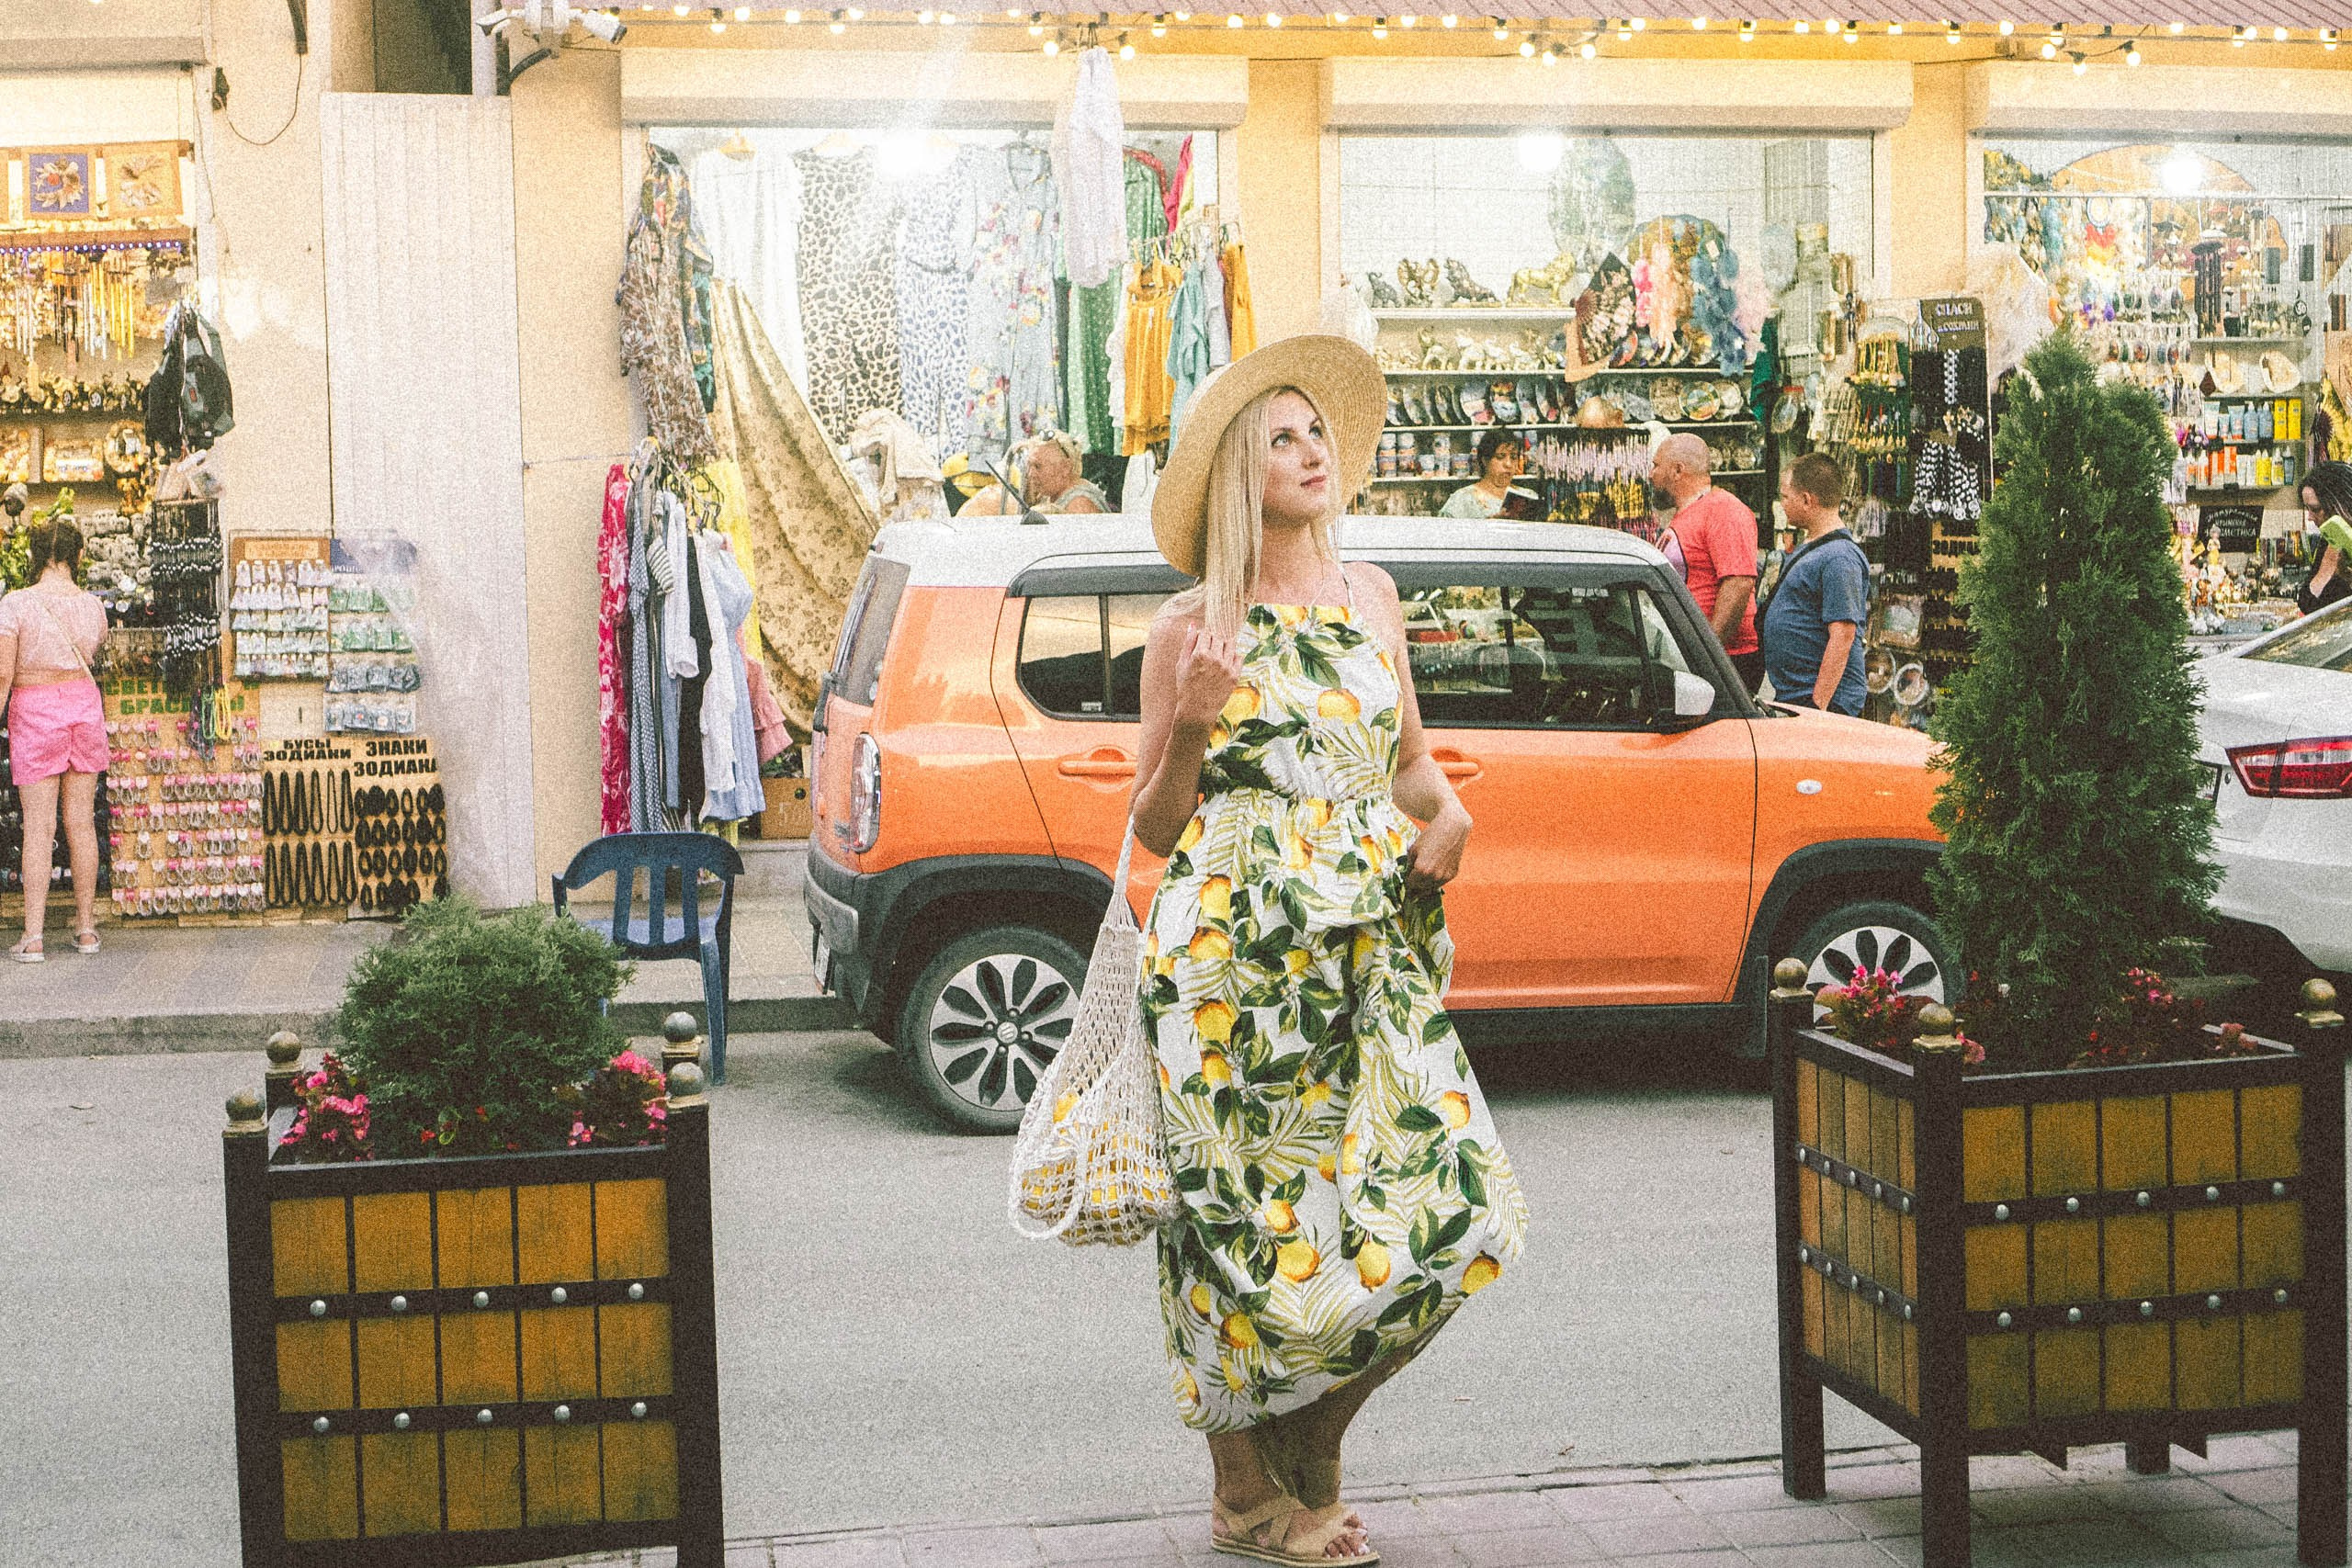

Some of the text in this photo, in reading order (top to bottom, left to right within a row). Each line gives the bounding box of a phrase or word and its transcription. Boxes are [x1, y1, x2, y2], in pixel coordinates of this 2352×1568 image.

[121, 695, 244, 715] БРАСЛЫ
[283, 738, 332, 750] БУСЫ
[366, 739, 428, 757] ЗНАКИ
